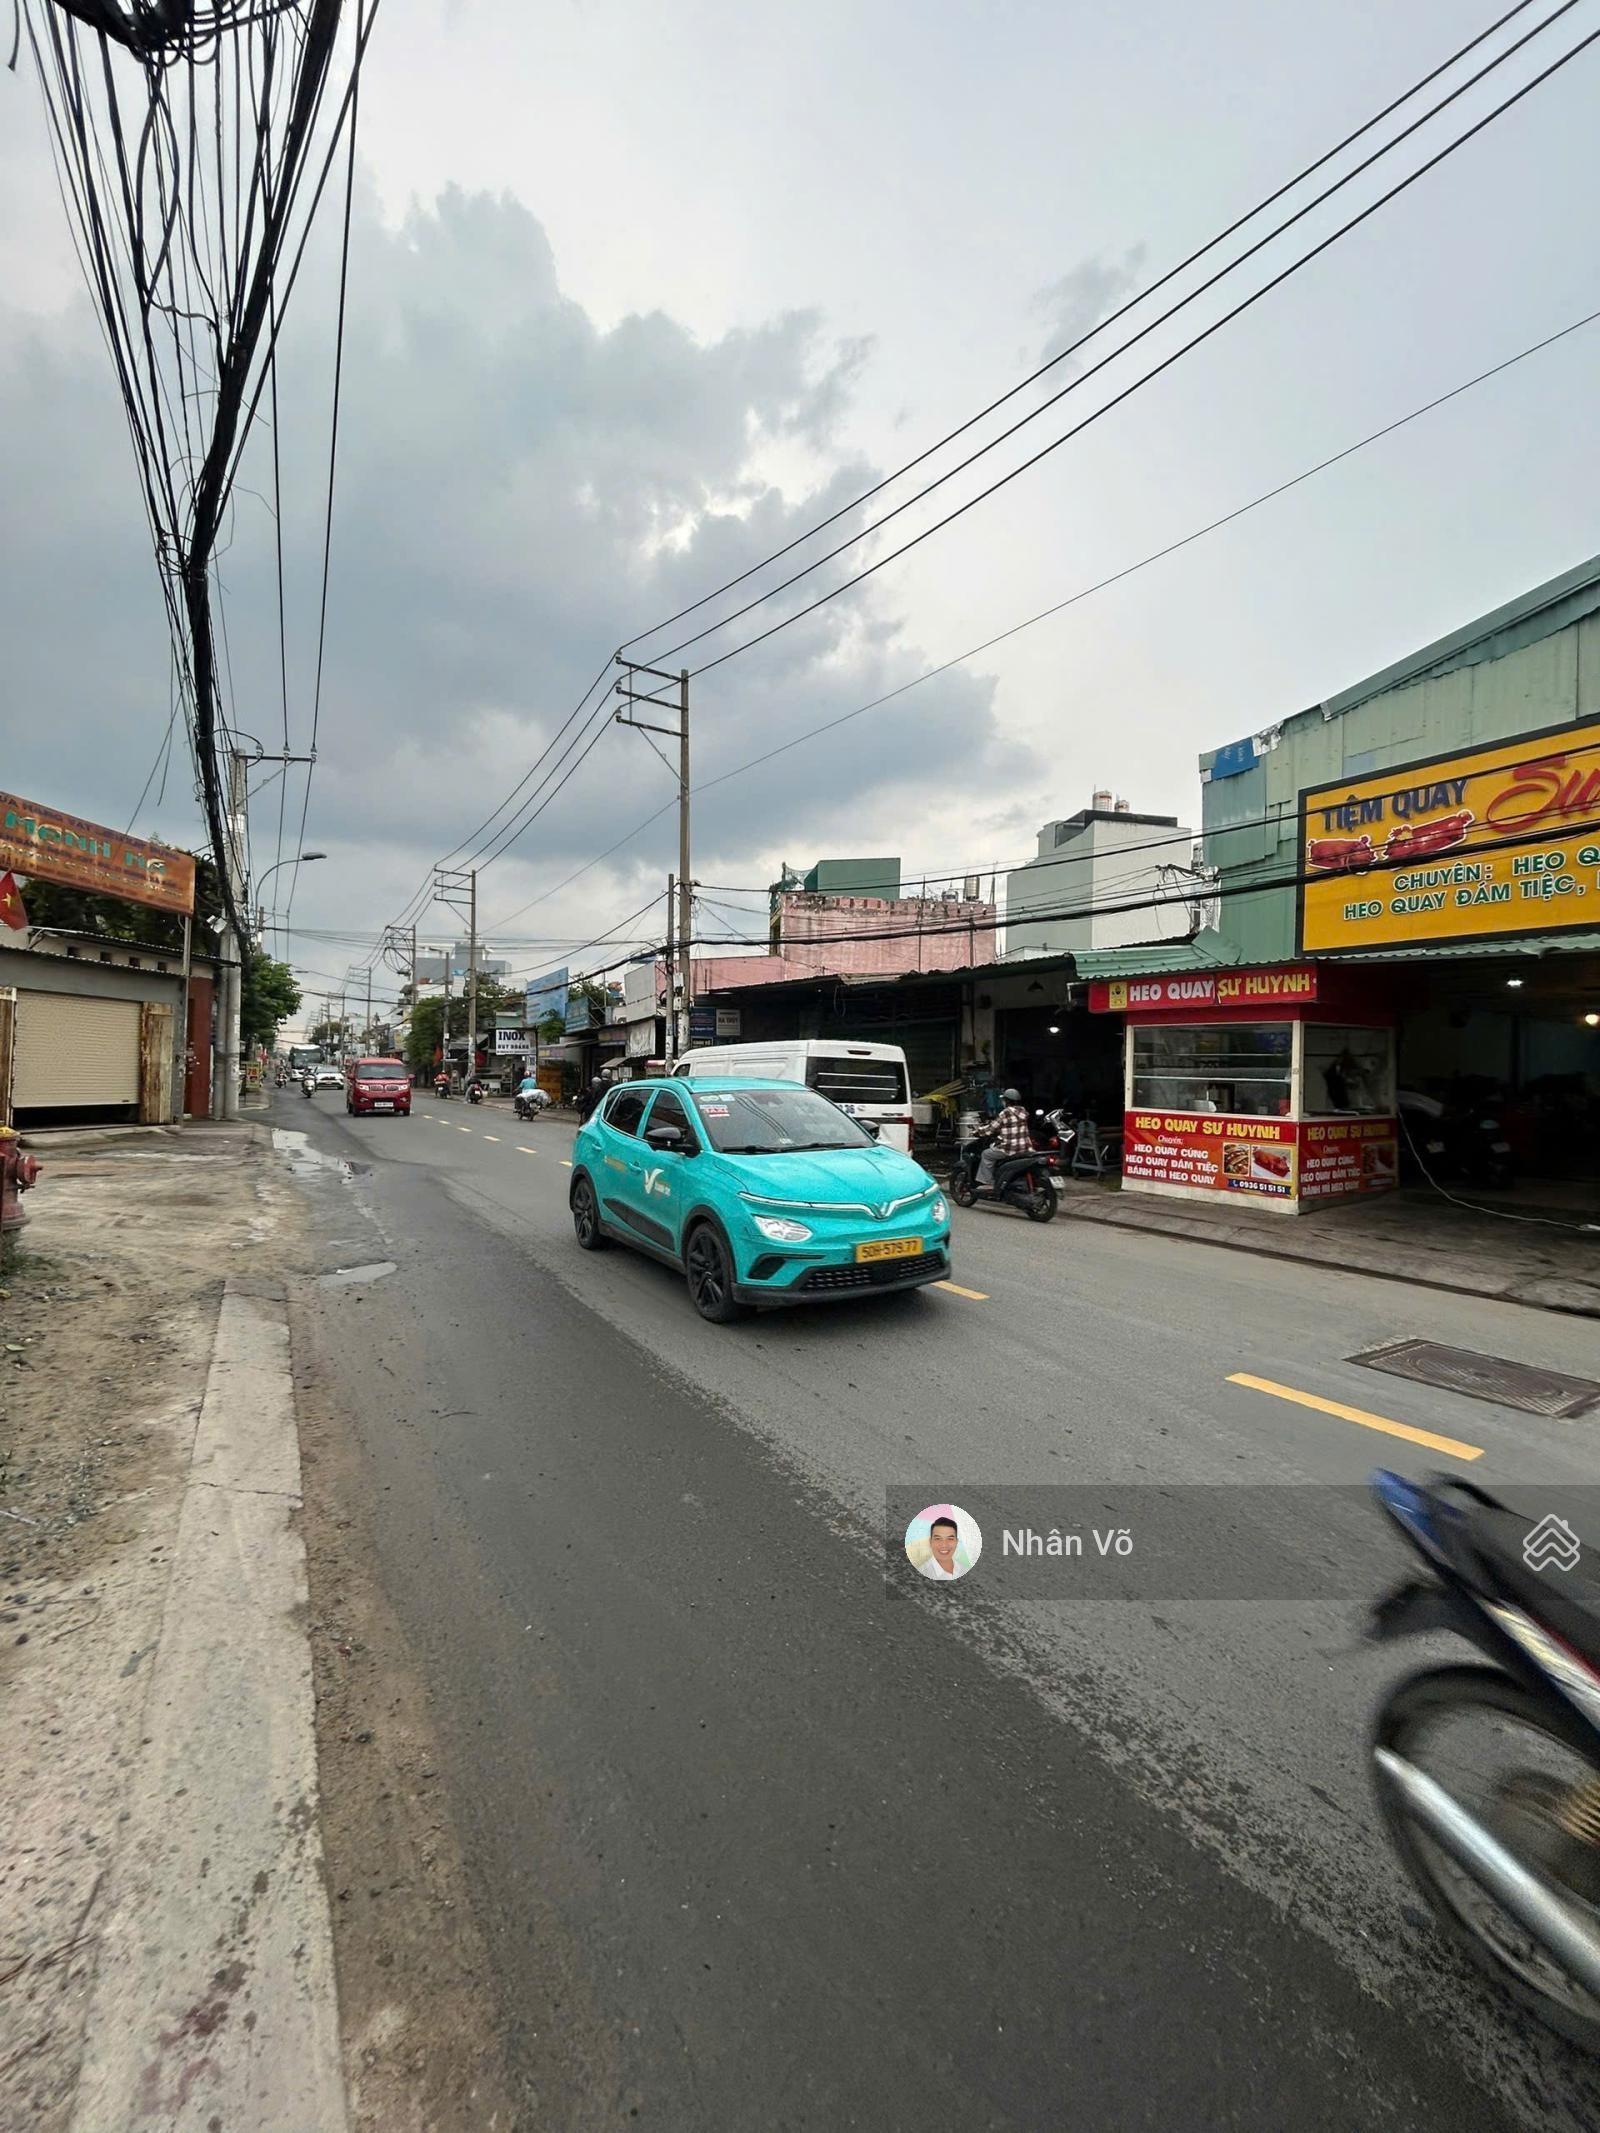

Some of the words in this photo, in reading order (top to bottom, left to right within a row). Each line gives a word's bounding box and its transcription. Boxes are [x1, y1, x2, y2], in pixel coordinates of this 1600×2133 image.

[1322, 794, 1383, 832] TIỆM
[1392, 780, 1468, 819] QUAY
[1393, 862, 1493, 892] CHUYÊN:
[1514, 851, 1565, 876] HEO
[1344, 900, 1383, 920] HEO
[1390, 891, 1446, 914] QUAY
[1456, 883, 1510, 907] ĐÁM
[1130, 984, 1161, 1001] HEO
[1167, 980, 1214, 1000] QUAY
[498, 1031, 526, 1041] INOX
[1135, 1117, 1161, 1129] HEO
[1165, 1119, 1198, 1133] QUAY
[1134, 1144, 1152, 1153] HEO
[1155, 1146, 1178, 1156] QUAY
[1126, 1154, 1143, 1164] HEO
[1146, 1156, 1168, 1167] QUAY
[1169, 1171, 1188, 1181] HEO
[1191, 1174, 1216, 1185] QUAY
